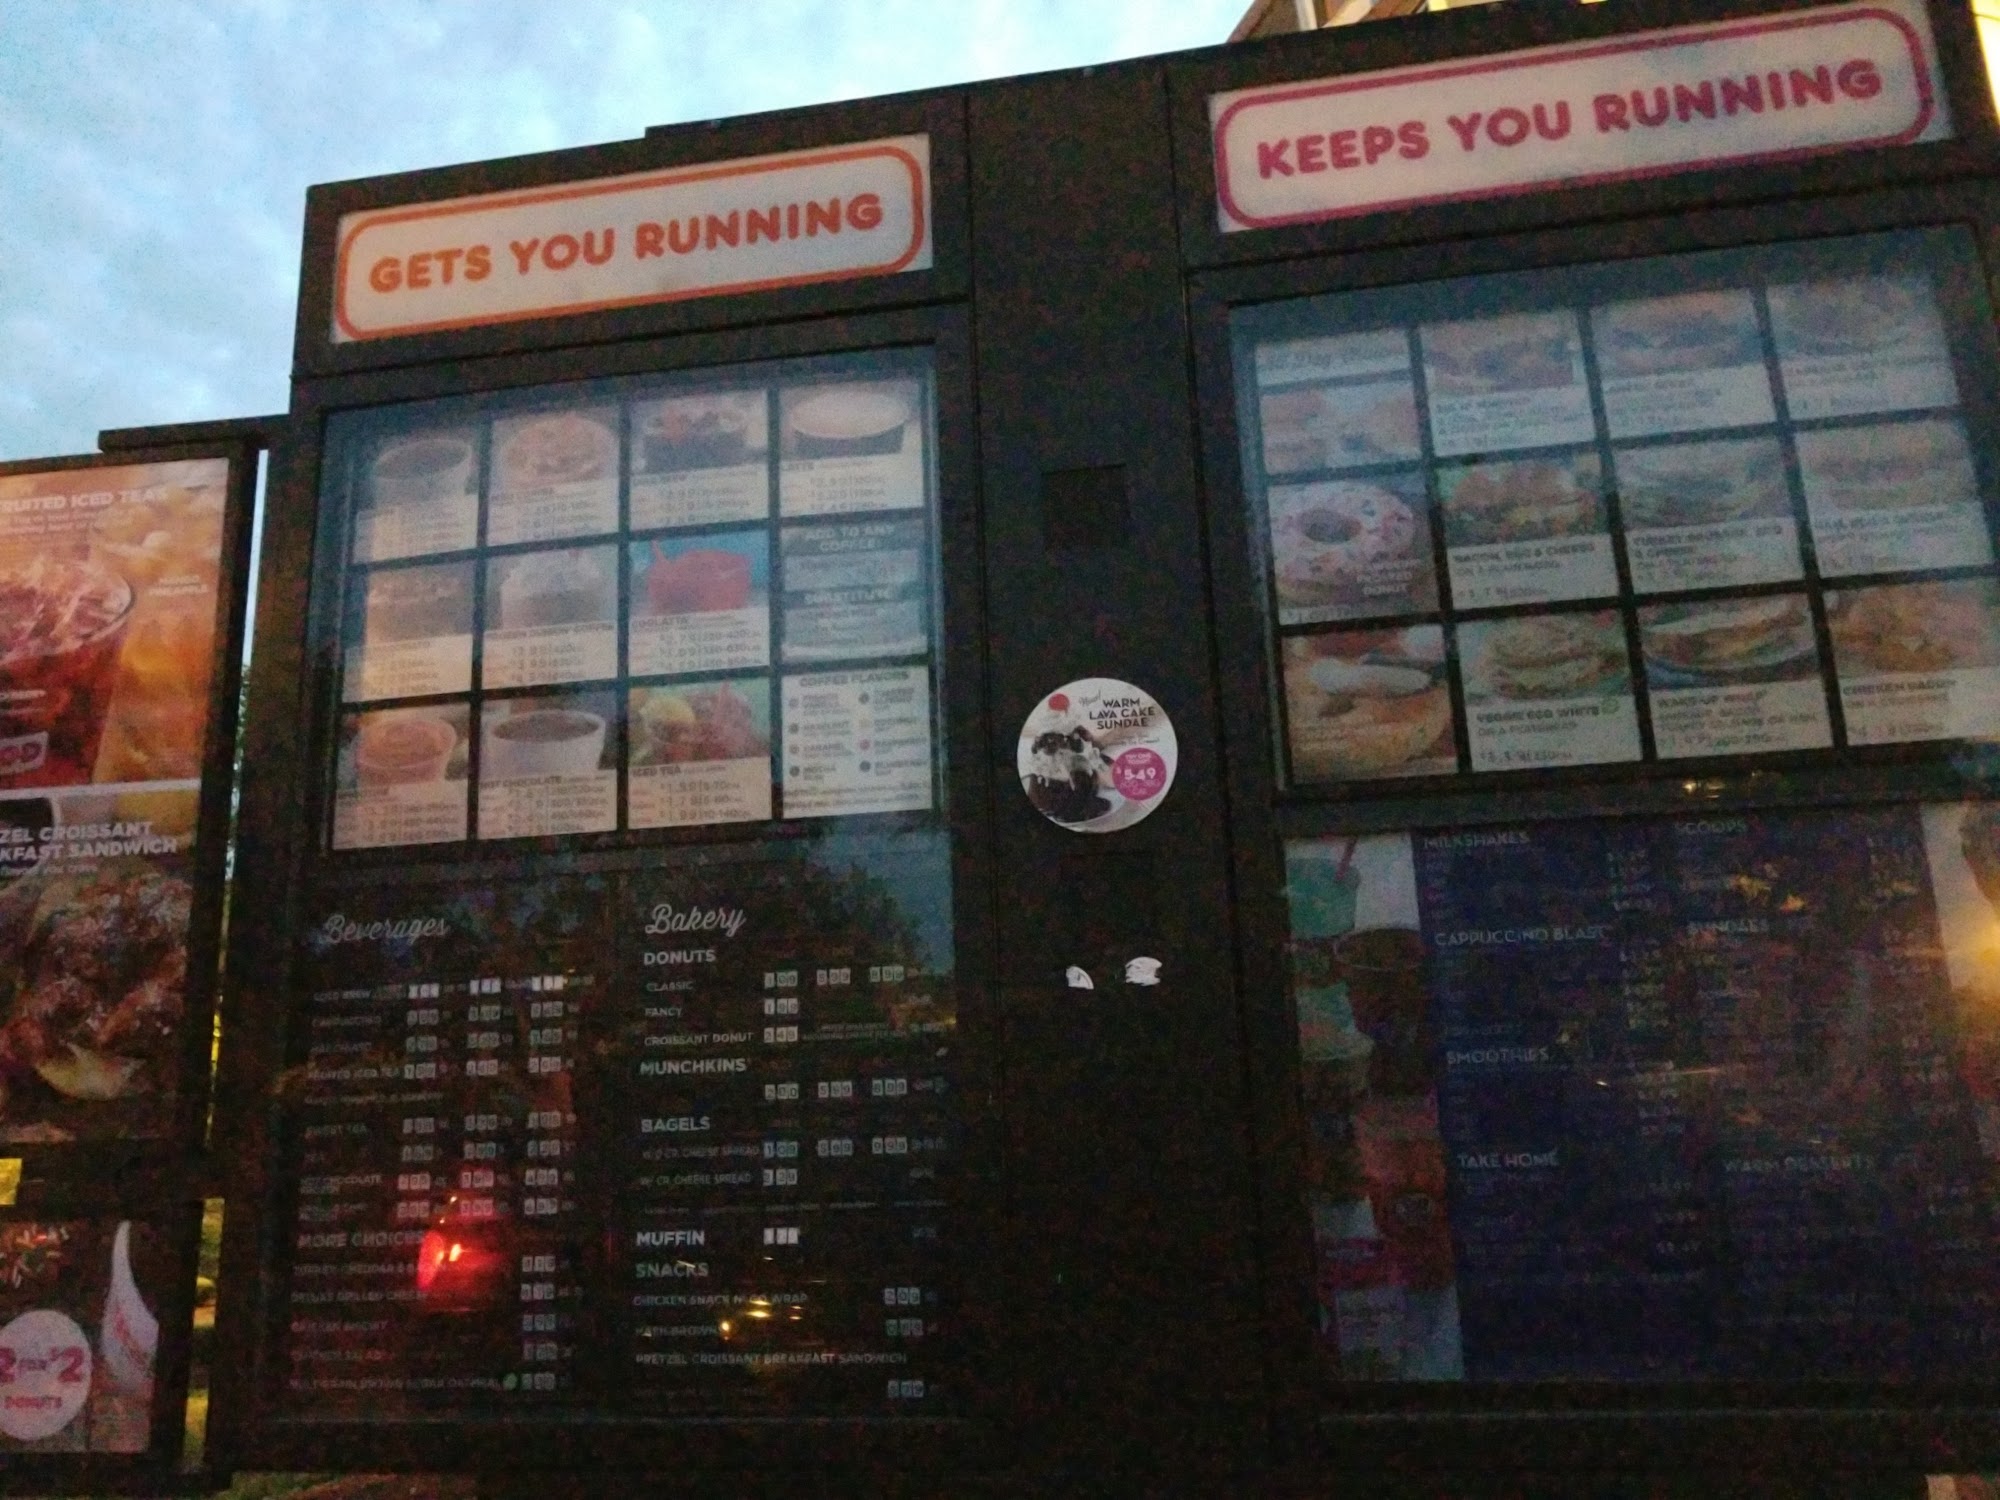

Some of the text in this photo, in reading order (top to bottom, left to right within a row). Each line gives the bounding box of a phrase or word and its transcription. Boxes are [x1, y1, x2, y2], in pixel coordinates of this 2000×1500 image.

[1256, 58, 1883, 180] KEEPS YOU RUNNING
[368, 192, 883, 294] GETS YOU RUNNING
[71, 492, 114, 507] ICED
[1103, 698, 1140, 708] WARM
[1089, 706, 1155, 720] LAVA CAKE
[1097, 717, 1149, 730] SUNDAE
[502, 775, 562, 788] CHOCOLATE
[39, 821, 152, 841] CROISSANT
[67, 837, 177, 858] SANDWICH
[1423, 832, 1531, 849] MILKSHAKES
[645, 904, 746, 938] Bakery
[325, 914, 448, 945] Beverages
[1434, 924, 1611, 946] CAPPUCCINO BLAST
[644, 950, 716, 966] DONUTS
[646, 981, 694, 992] CLASSIC
[644, 1007, 682, 1018] FANCY
[644, 1032, 754, 1047] CROISSANT DONUT
[1446, 1046, 1549, 1065] SMOOTHIES
[640, 1058, 747, 1075] MUNCHKINS
[641, 1116, 710, 1133] BAGELS
[1457, 1149, 1559, 1168] TAKE HOME
[674, 1174, 712, 1185] CHEESE
[298, 1232, 347, 1248] MORE
[636, 1230, 705, 1246] MUFFIN
[636, 1261, 709, 1278] SNACKS
[636, 1353, 687, 1364] PRETZEL
[691, 1353, 760, 1364] CROISSANT
[764, 1353, 835, 1364] BREAKFAST
